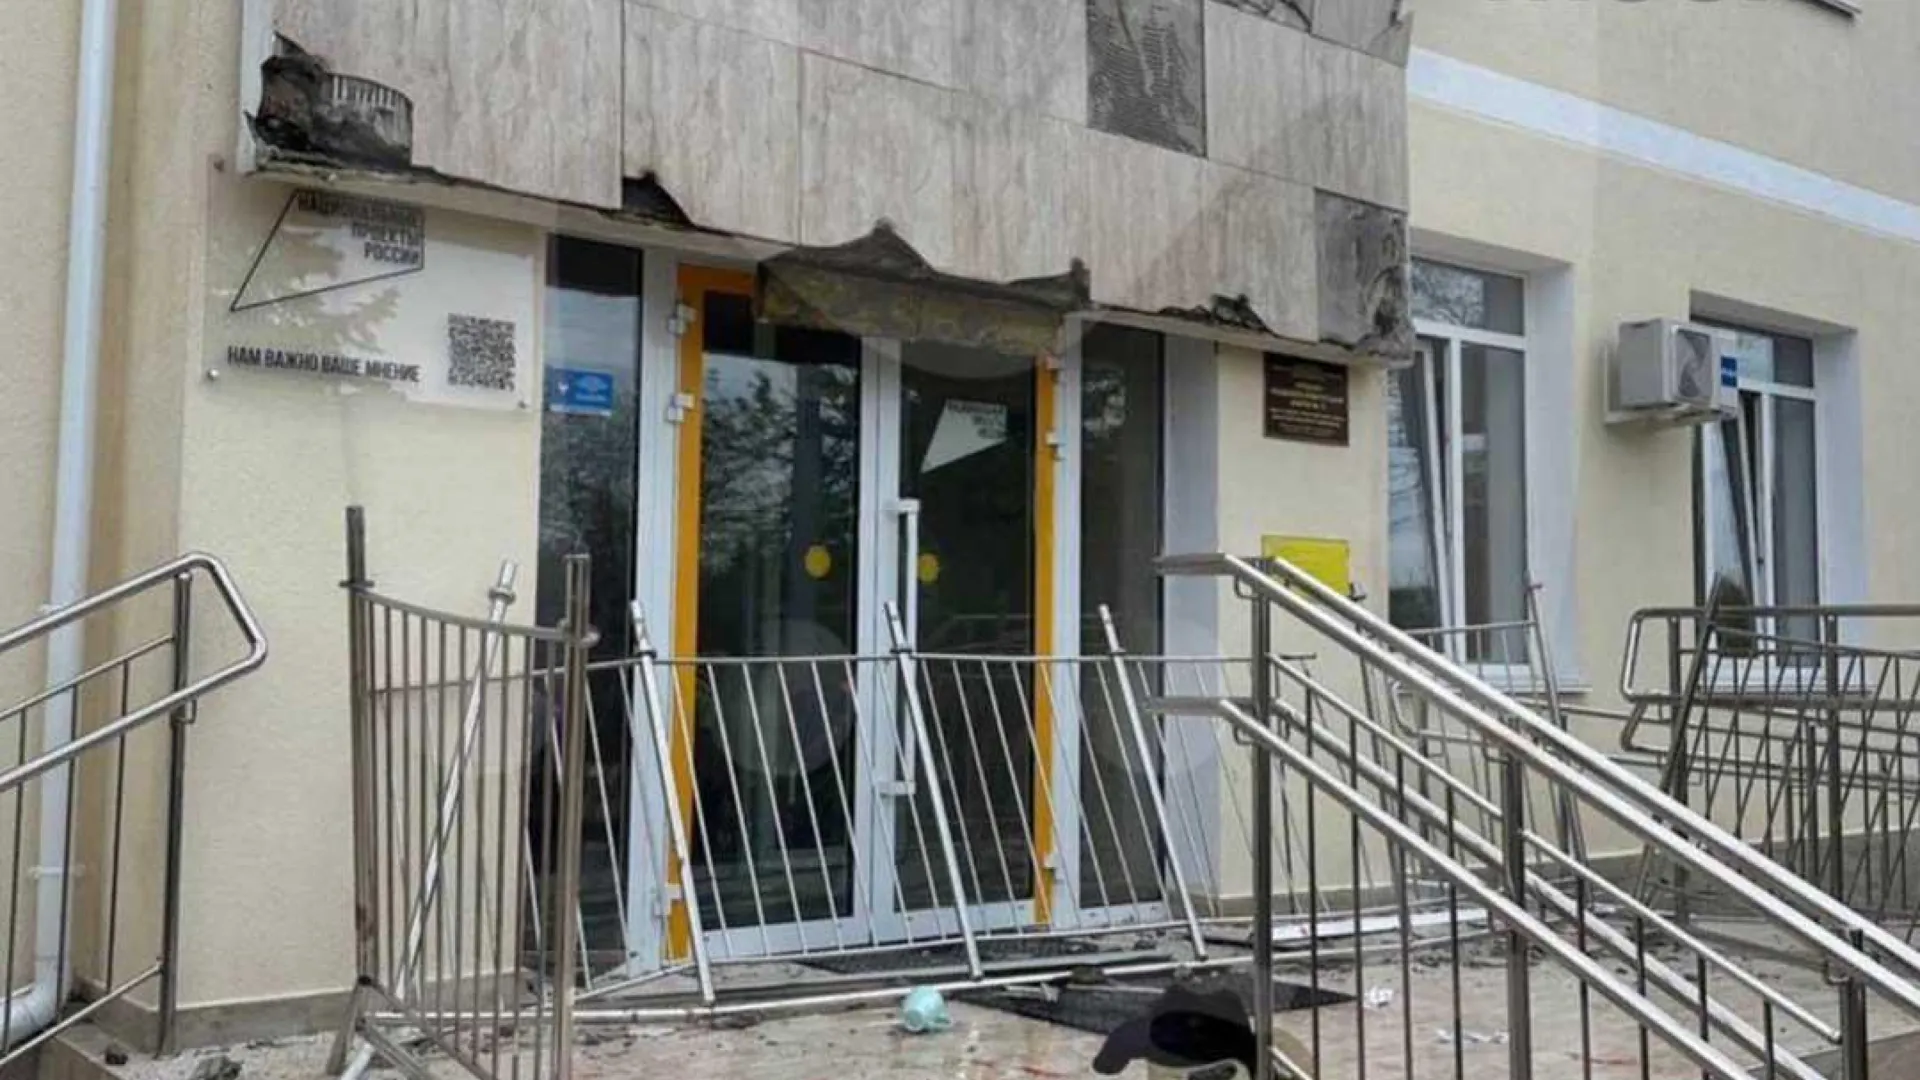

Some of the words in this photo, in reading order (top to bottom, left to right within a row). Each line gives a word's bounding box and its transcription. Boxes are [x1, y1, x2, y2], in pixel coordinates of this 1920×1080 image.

[364, 242, 420, 264] РОССИИ
[227, 346, 262, 367] НАМ
[264, 348, 319, 372] ВАЖНО
[321, 354, 362, 377] ВАШЕ
[364, 359, 421, 383] МНЕНИЕ
